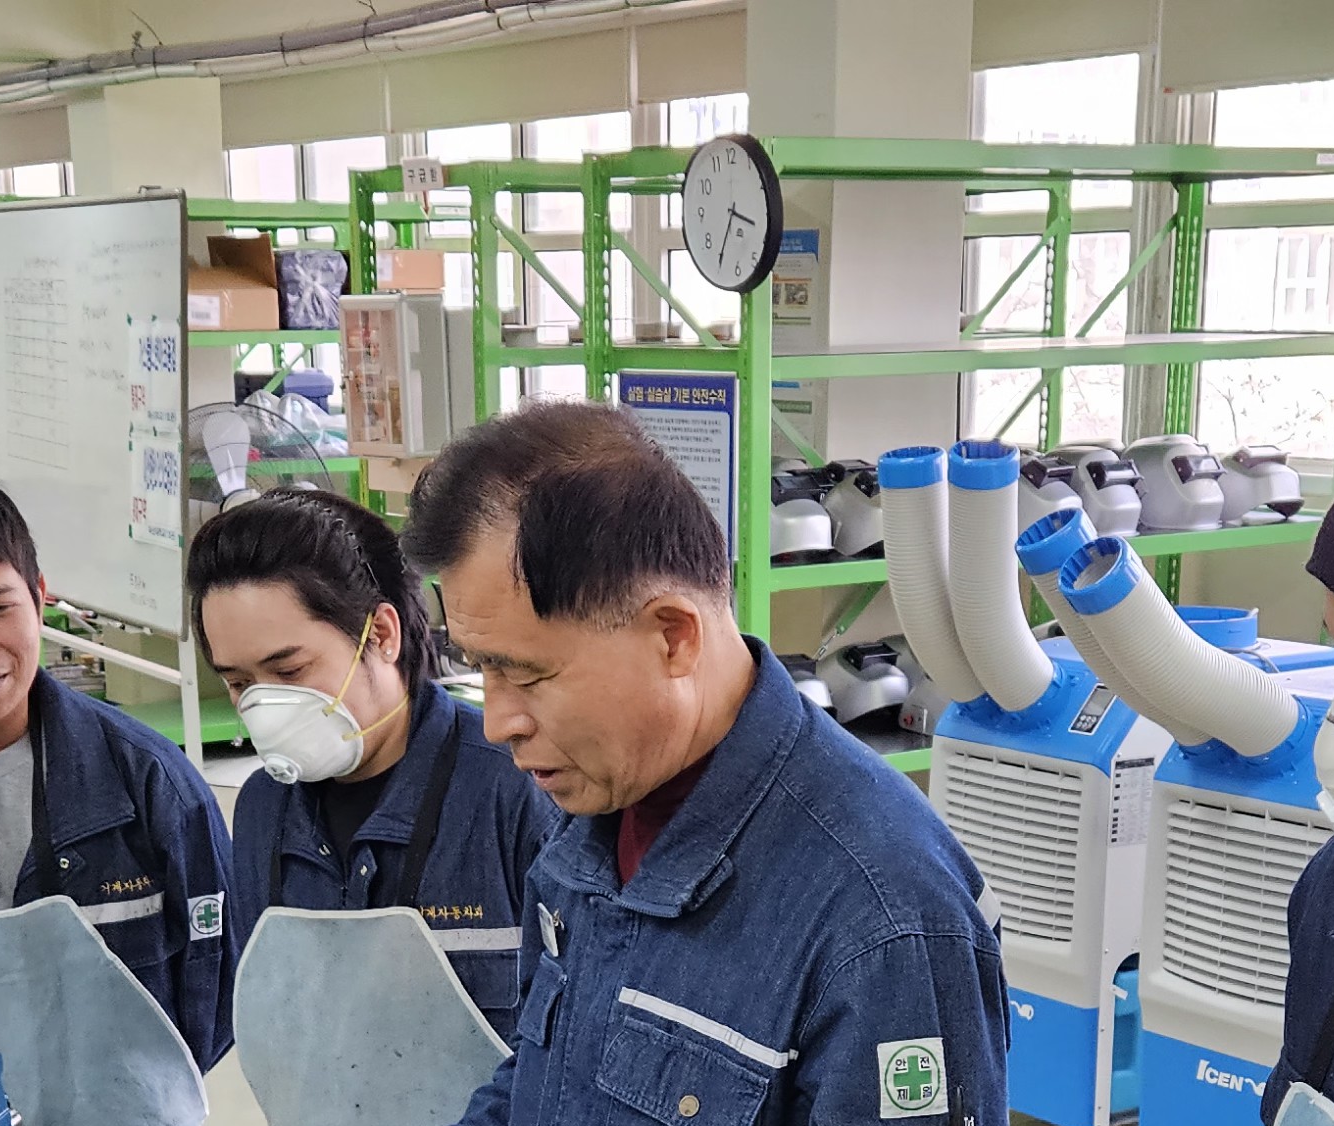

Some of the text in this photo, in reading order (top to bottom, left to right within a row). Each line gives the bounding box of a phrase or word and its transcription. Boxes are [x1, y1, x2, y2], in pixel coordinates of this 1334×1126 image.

[711, 155, 721, 173] 11
[726, 147, 737, 165] 12
[700, 178, 712, 196] 10
[697, 206, 705, 224] 9
[704, 232, 713, 250] 8
[734, 260, 742, 277] 6
